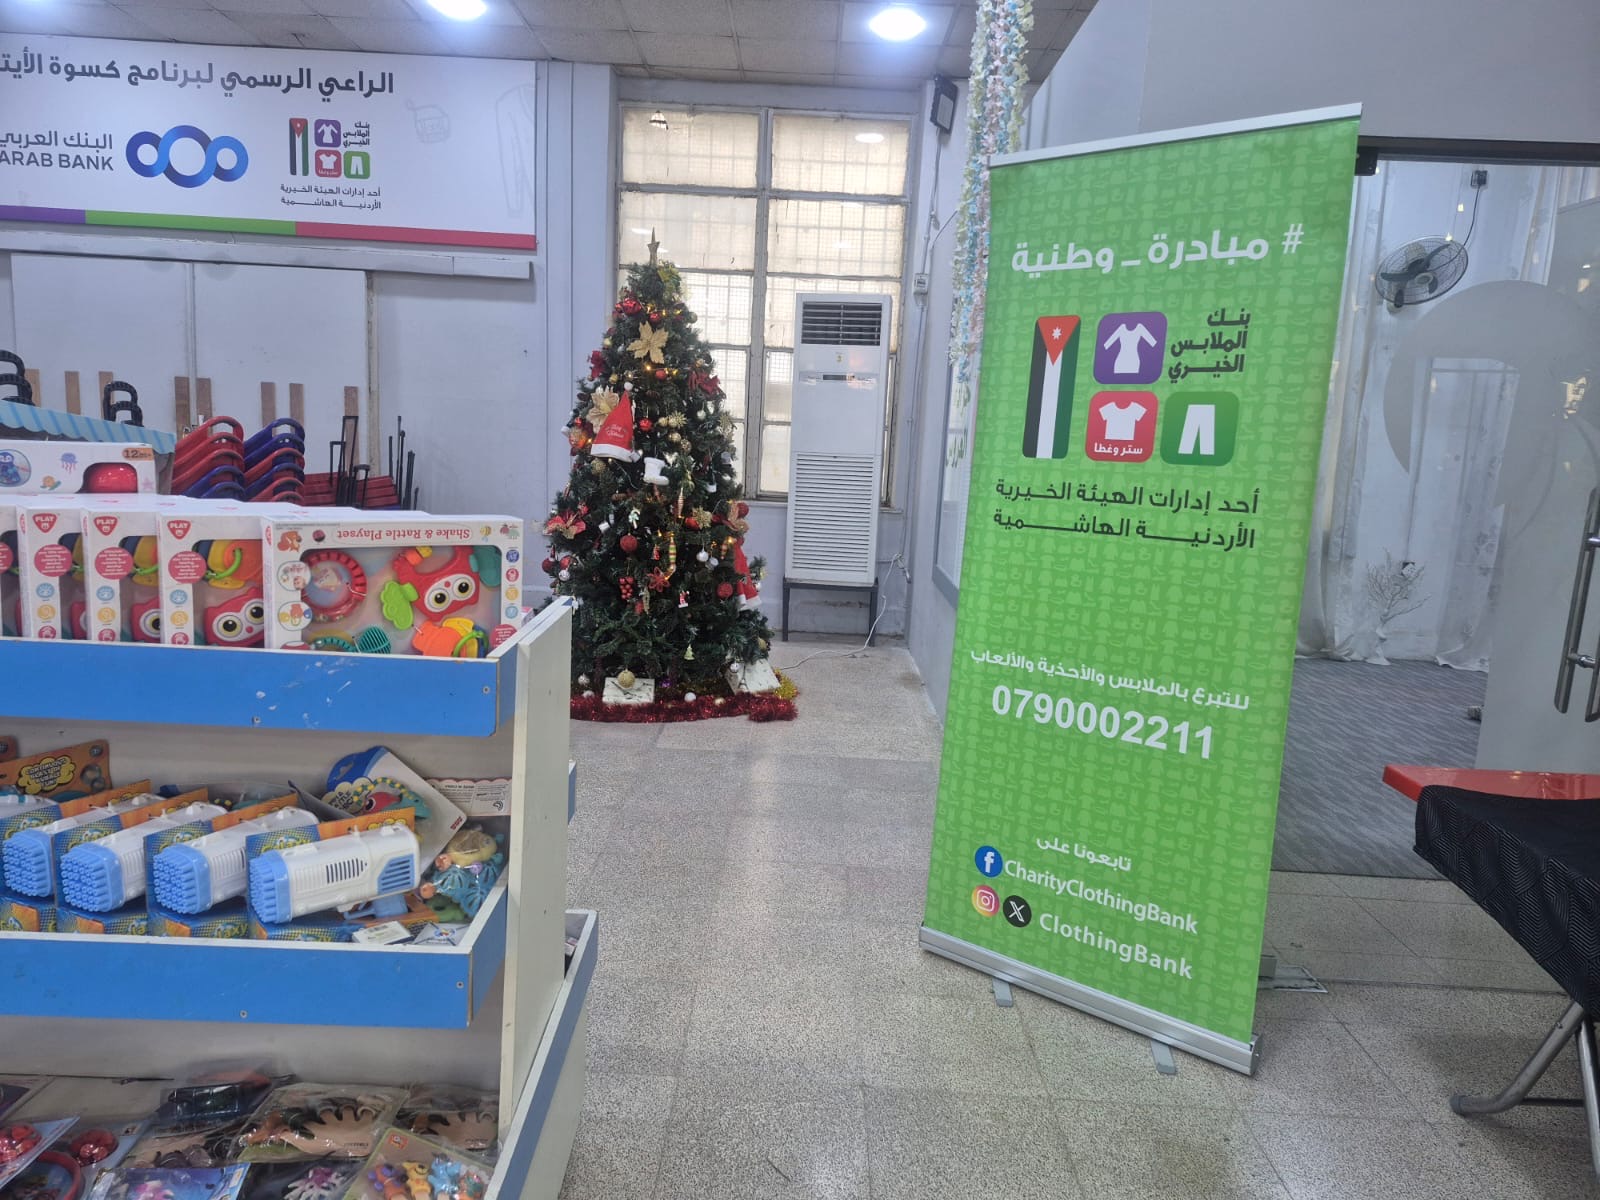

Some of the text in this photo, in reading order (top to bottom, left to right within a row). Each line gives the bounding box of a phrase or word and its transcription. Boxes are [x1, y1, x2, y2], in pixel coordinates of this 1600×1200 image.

[49, 55, 121, 82] كسوة
[127, 60, 214, 89] لبرنامج
[220, 67, 312, 98] الرسمي
[316, 70, 394, 102] الراعي
[0, 130, 113, 152] البنك العربي
[0, 150, 114, 171] ARAB BANK
[367, 187, 381, 197] أحد
[1010, 240, 1115, 279] وطنية
[1147, 229, 1269, 270] مبادرة
[1206, 308, 1251, 328] بنك
[1170, 330, 1249, 357] الملابس
[1168, 353, 1245, 384] الخيري
[995, 478, 1259, 516] أحد إدارات الهيئة الخيرية
[35, 514, 55, 524] PLAY
[95, 518, 116, 526] PLAY
[169, 521, 189, 530] PLAY
[337, 528, 470, 541] Shake & Rattle Playset
[992, 508, 1256, 553] الأردنية الهاشمية
[970, 646, 1250, 711] للتبرع بالملابس والأحذية والألعاب
[991, 684, 1212, 760] 0790002211
[1036, 836, 1131, 873] تابعونا على
[1004, 859, 1199, 936] CharityClothingBank
[1038, 912, 1193, 980] ClothingBank
